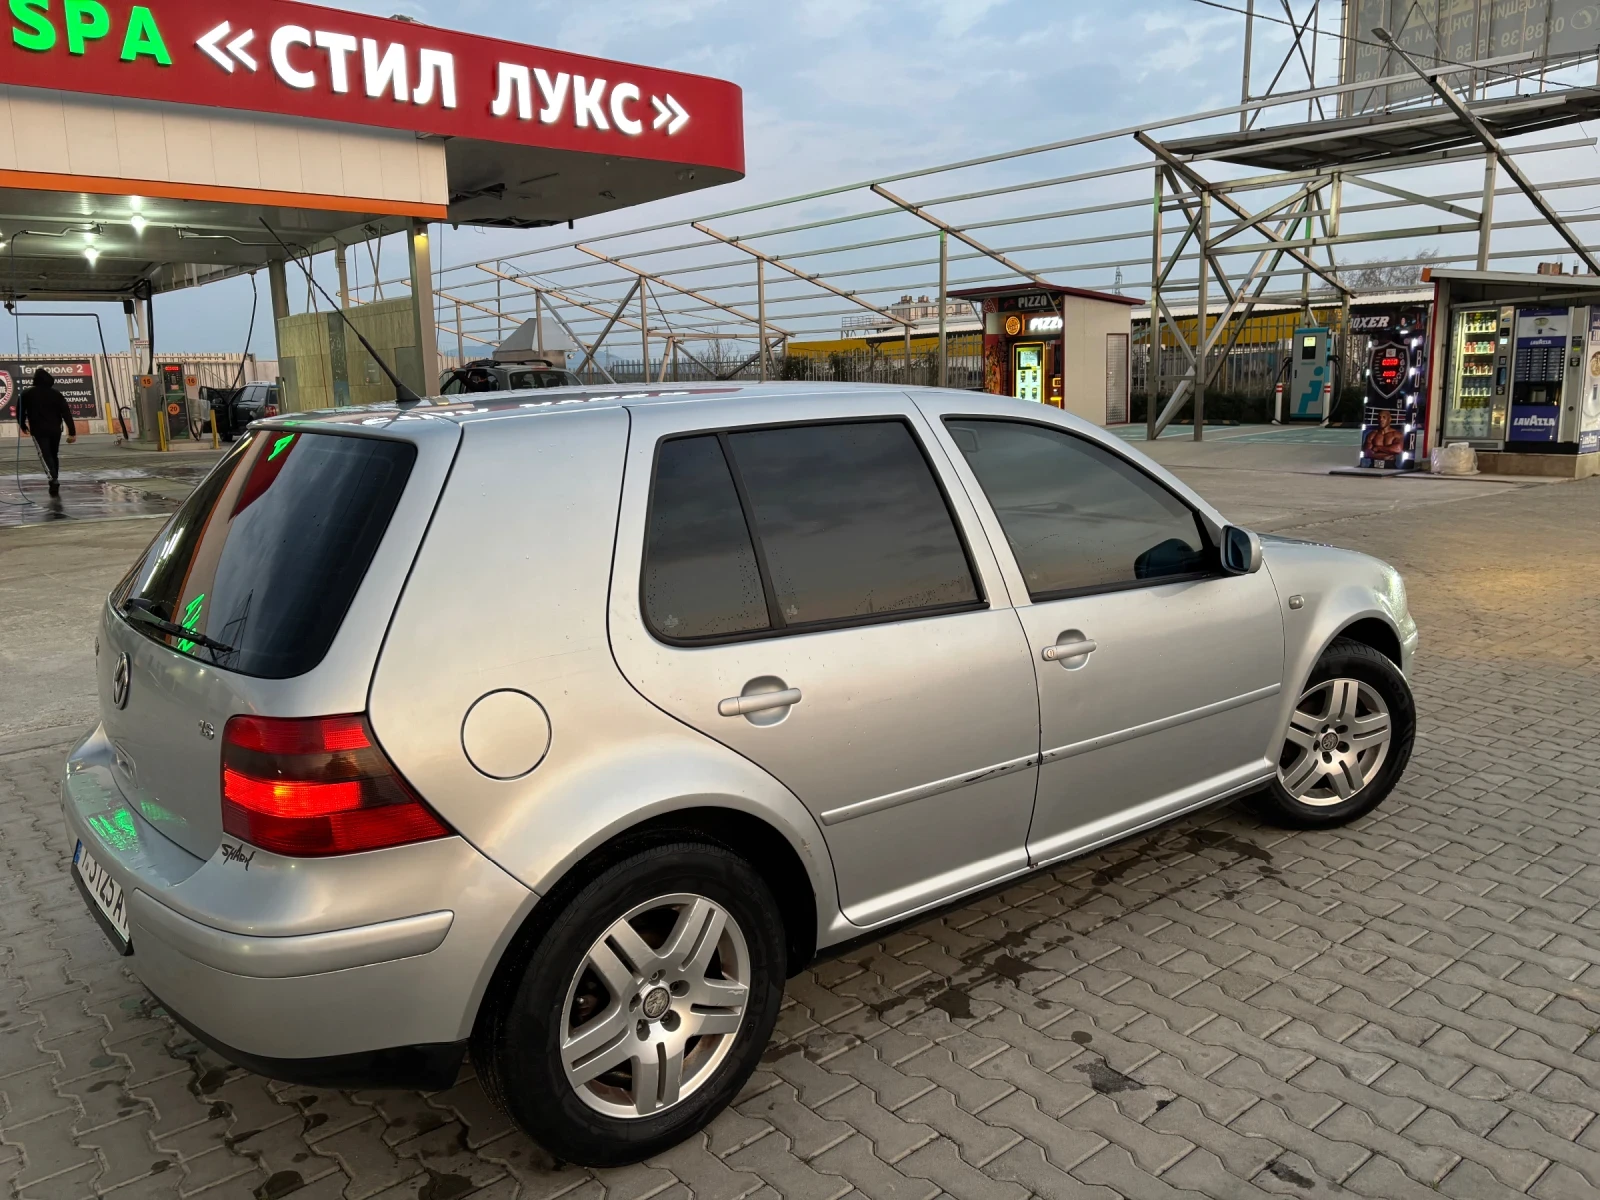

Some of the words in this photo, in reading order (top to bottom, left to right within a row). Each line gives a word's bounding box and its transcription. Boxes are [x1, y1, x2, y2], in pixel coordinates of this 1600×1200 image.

[9, 0, 172, 64] SPA
[1018, 295, 1047, 308] PIZZA
[76, 364, 84, 373] 2
[1513, 414, 1556, 427] LAVAZZA
